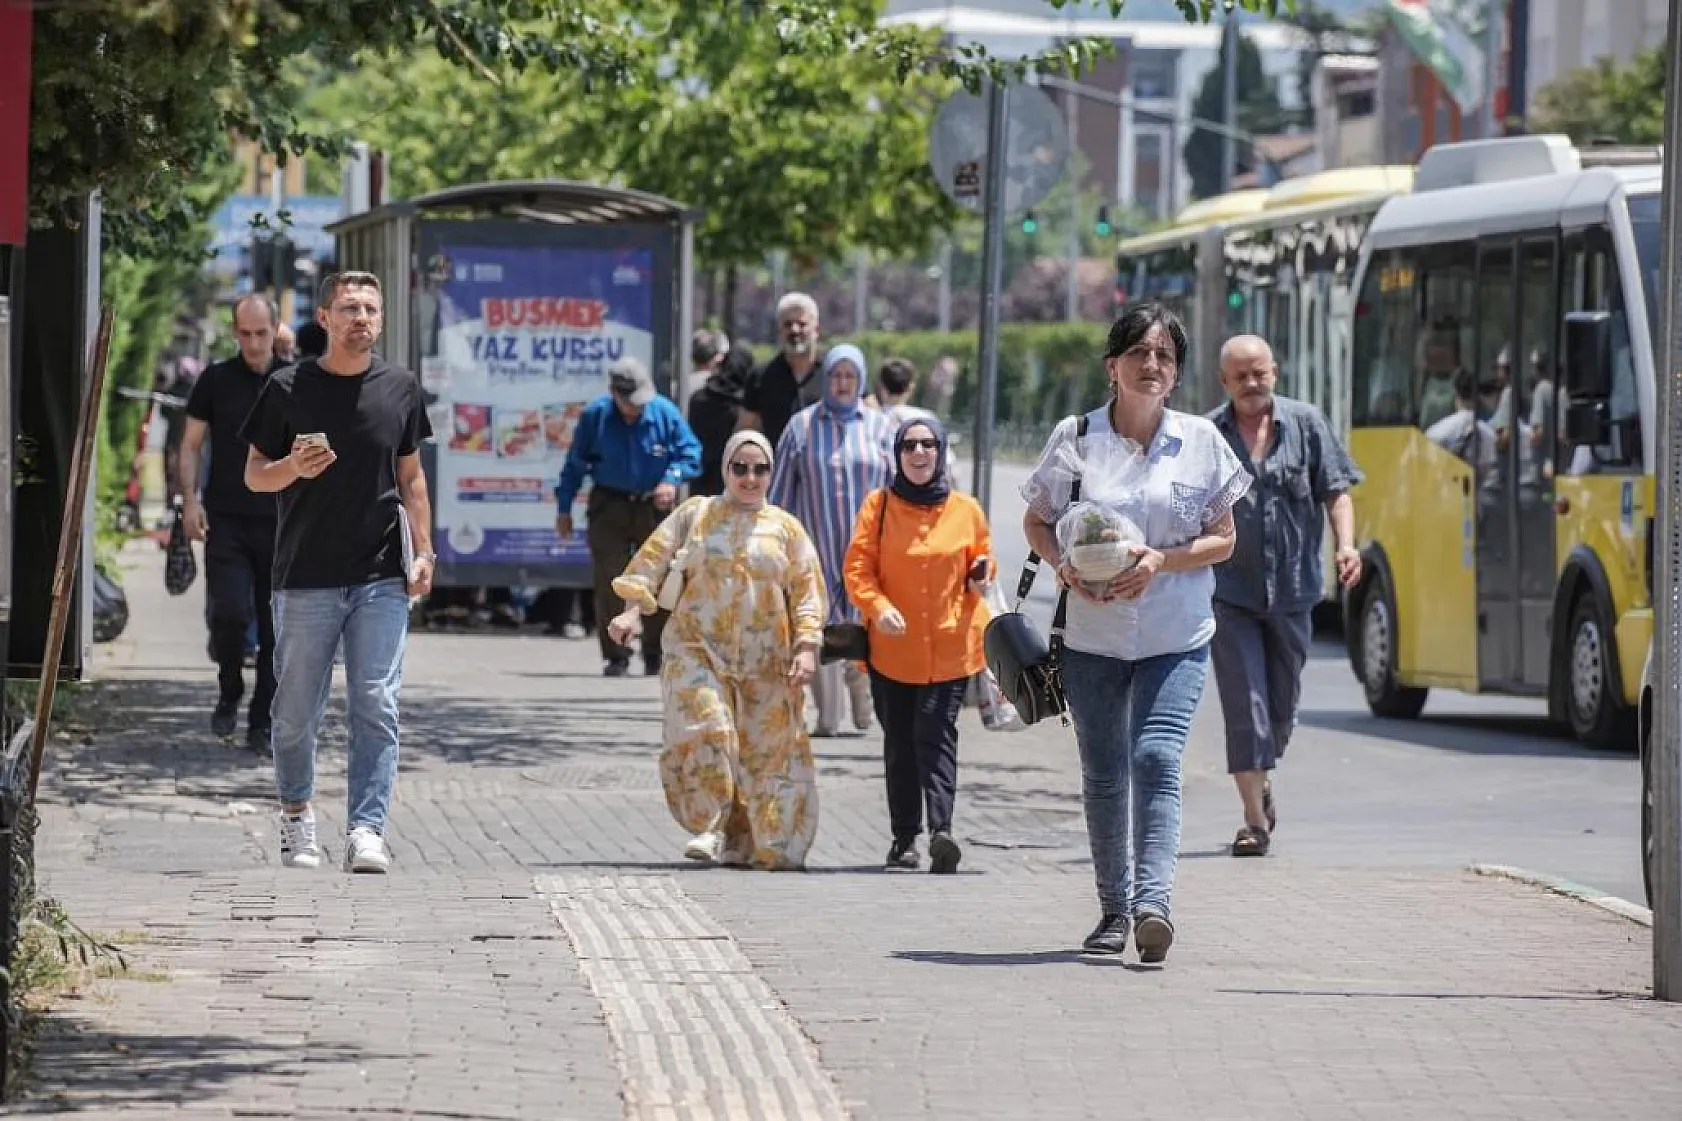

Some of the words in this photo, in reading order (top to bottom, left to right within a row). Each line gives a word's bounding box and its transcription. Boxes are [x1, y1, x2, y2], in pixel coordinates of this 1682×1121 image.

[484, 298, 606, 328] BUSMEK
[467, 336, 517, 361] YAZ
[531, 336, 624, 361] KURSU
